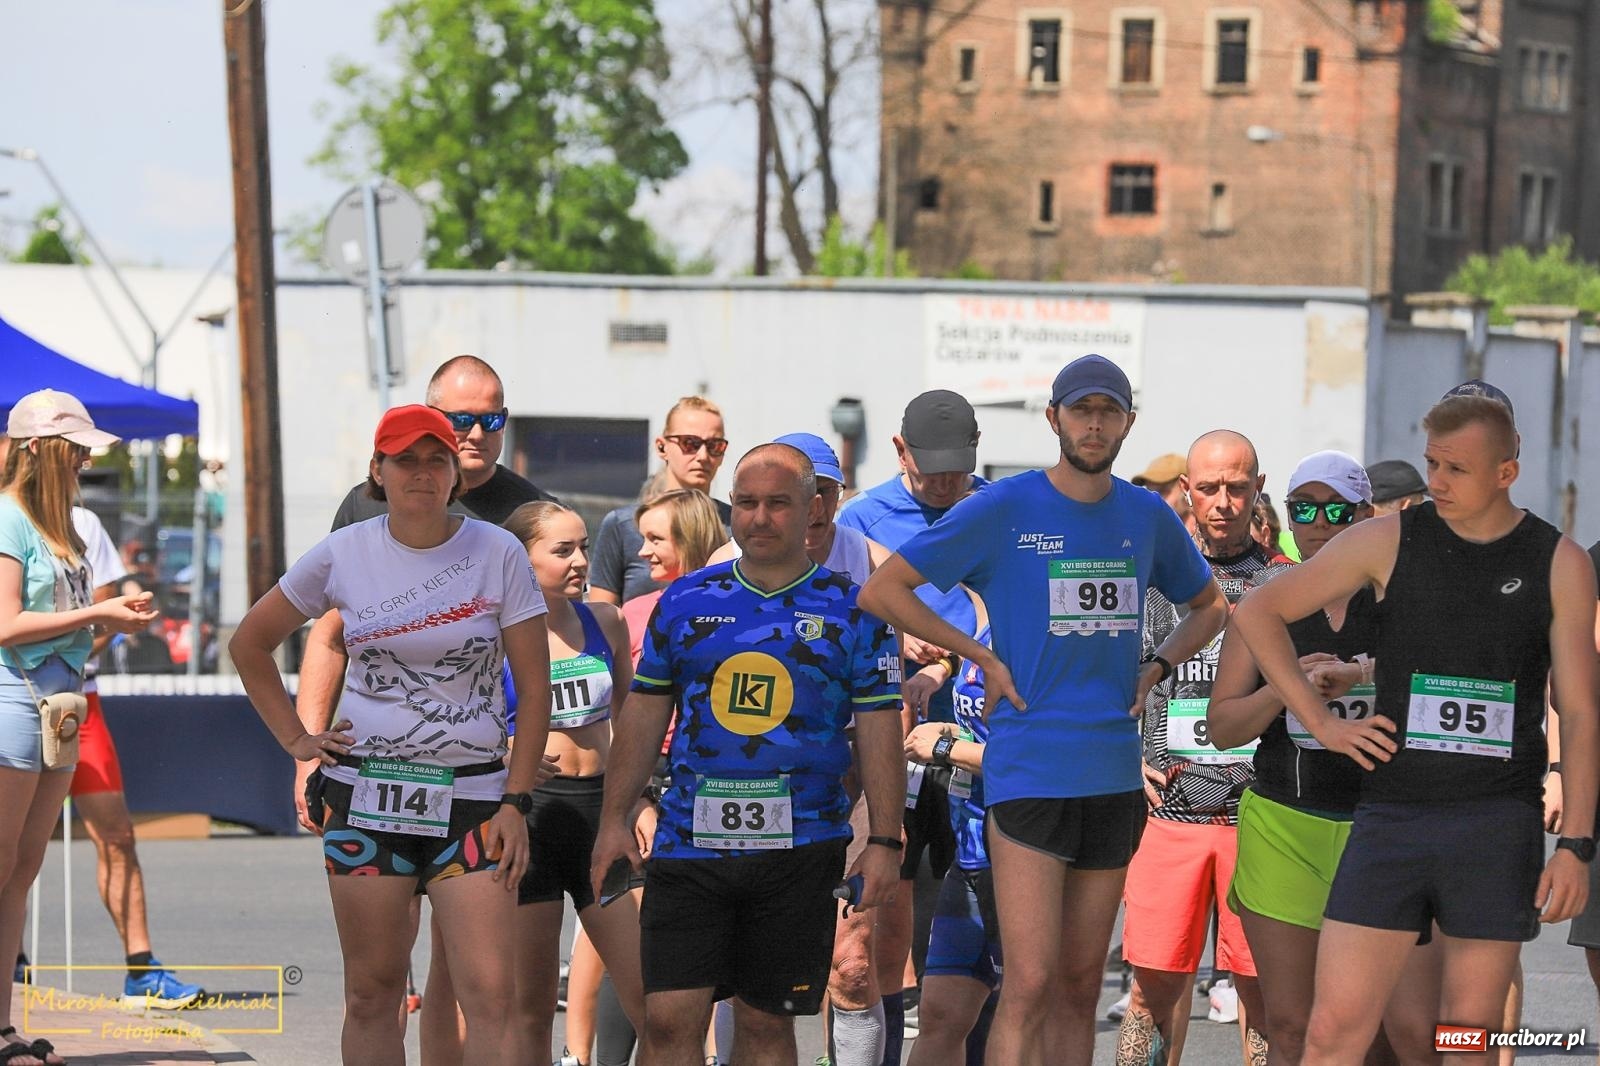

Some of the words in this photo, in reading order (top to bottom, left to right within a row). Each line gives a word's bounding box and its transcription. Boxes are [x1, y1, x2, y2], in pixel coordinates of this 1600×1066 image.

[1009, 325, 1132, 345] Podnoszenia
[1018, 533, 1044, 543] JUST
[1036, 540, 1064, 550] TEAM
[357, 605, 377, 622] KS
[380, 587, 419, 613] GRYF
[1078, 581, 1119, 611] 98
[551, 678, 591, 711] 111
[1440, 679, 1458, 687] BIEG
[1475, 682, 1504, 692] GRANIC
[1439, 700, 1487, 734] 95
[383, 763, 399, 771] BIEG
[399, 764, 413, 772] BEZ
[413, 766, 444, 776] GRANIC
[718, 781, 734, 789] BIEG
[735, 781, 750, 789] BEZ
[750, 780, 779, 789] GRANIC
[376, 782, 428, 816] 114
[721, 801, 766, 831] 83
